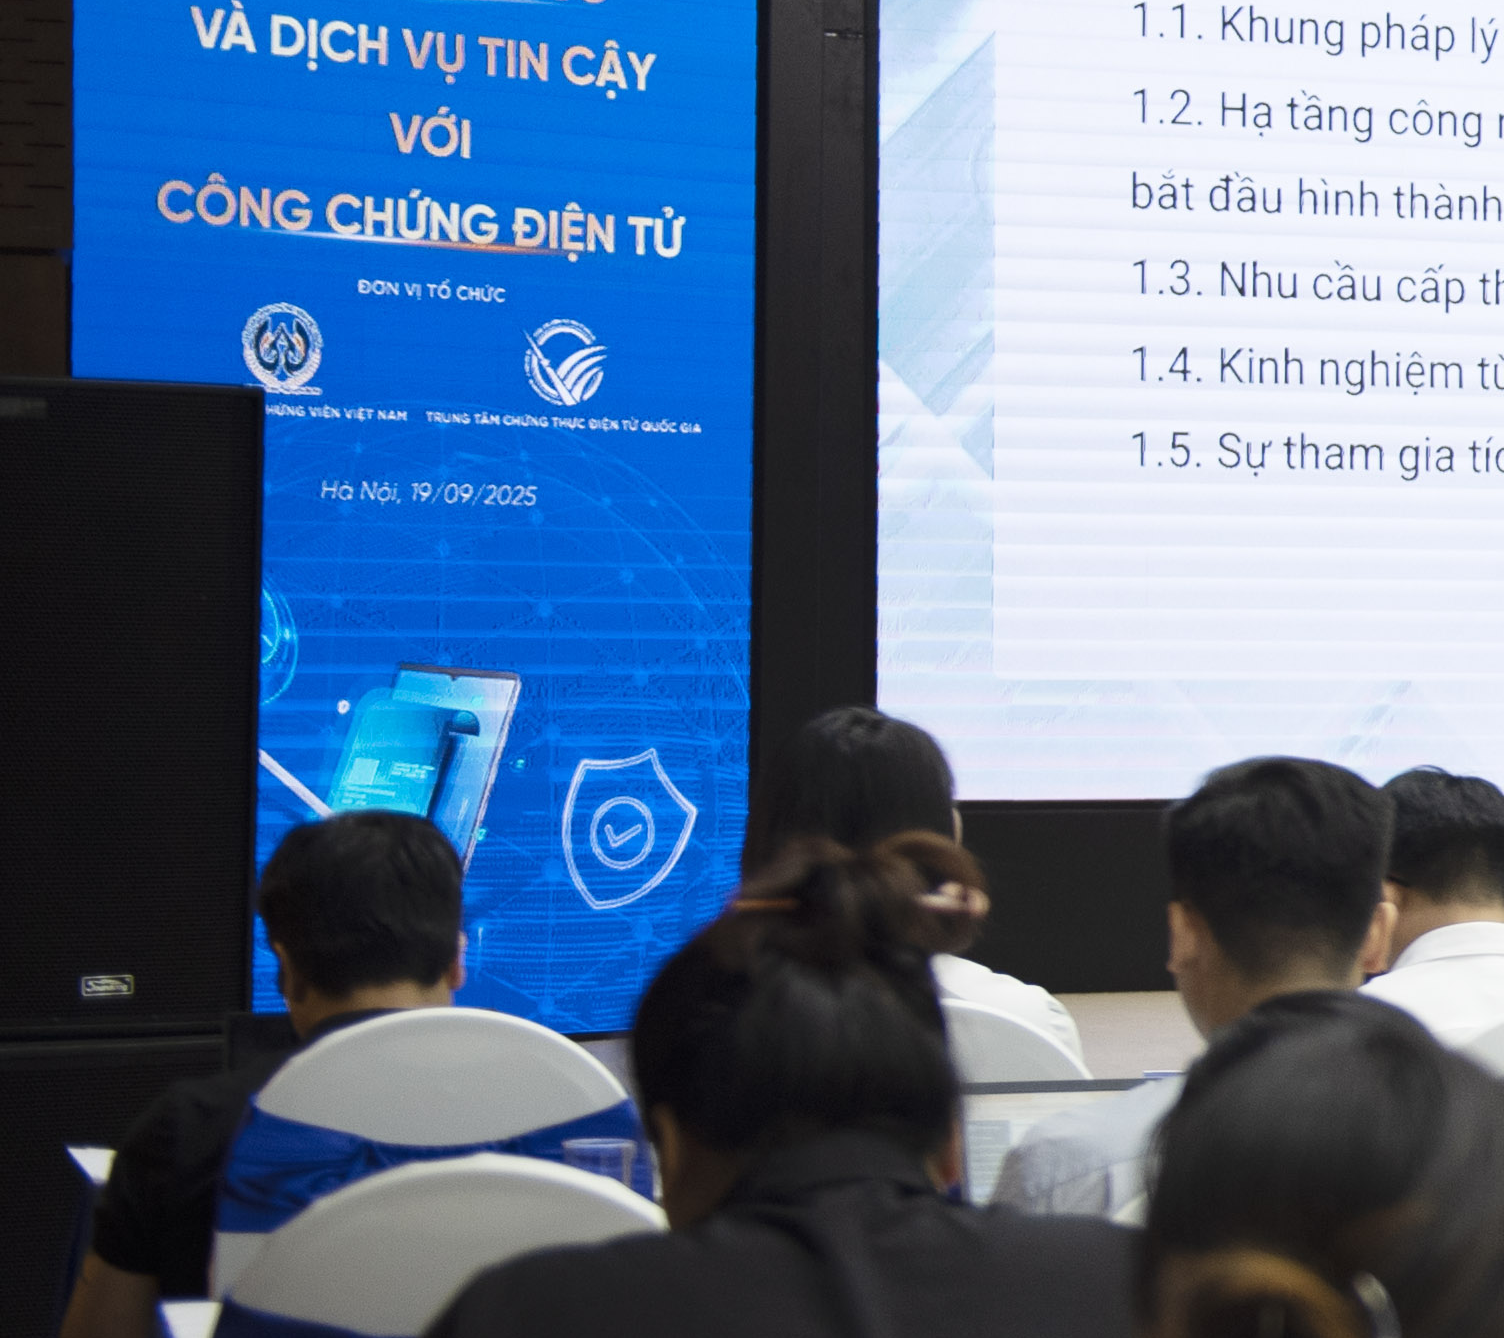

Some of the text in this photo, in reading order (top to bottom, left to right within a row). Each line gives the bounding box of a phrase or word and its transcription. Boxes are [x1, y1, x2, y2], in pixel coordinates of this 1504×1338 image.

[191, 0, 656, 99] VÀ DỊCH VỤ TIN CẬY
[1134, 2, 1202, 39] 1.1.
[1222, 5, 1343, 56] Khung
[1361, 12, 1455, 61] pháp
[1472, 17, 1498, 64] lý
[390, 106, 470, 158] VỚI
[1134, 89, 1202, 125] 1.2.
[1222, 92, 1272, 137] Hạ
[1287, 90, 1372, 139] tầng
[1389, 100, 1482, 148] công
[158, 173, 686, 262] CÔNG CHỨNG ĐIỆN TỬ
[1132, 170, 1194, 210] bắt
[1209, 172, 1281, 213] đầu
[1299, 178, 1378, 216] hình
[1393, 182, 1502, 221] thành
[1133, 259, 1202, 296] 1.3.
[1221, 261, 1297, 299] Nhu
[1313, 260, 1381, 301] cầu
[1397, 264, 1465, 313] cấp
[1133, 346, 1201, 382] 1.4.
[1221, 347, 1303, 384] Kinh
[1320, 350, 1463, 395] nghiệm
[1132, 432, 1200, 467] 1.5.
[1218, 432, 1272, 477] Sự
[1283, 433, 1384, 470] tham
[1399, 437, 1454, 481] gia
